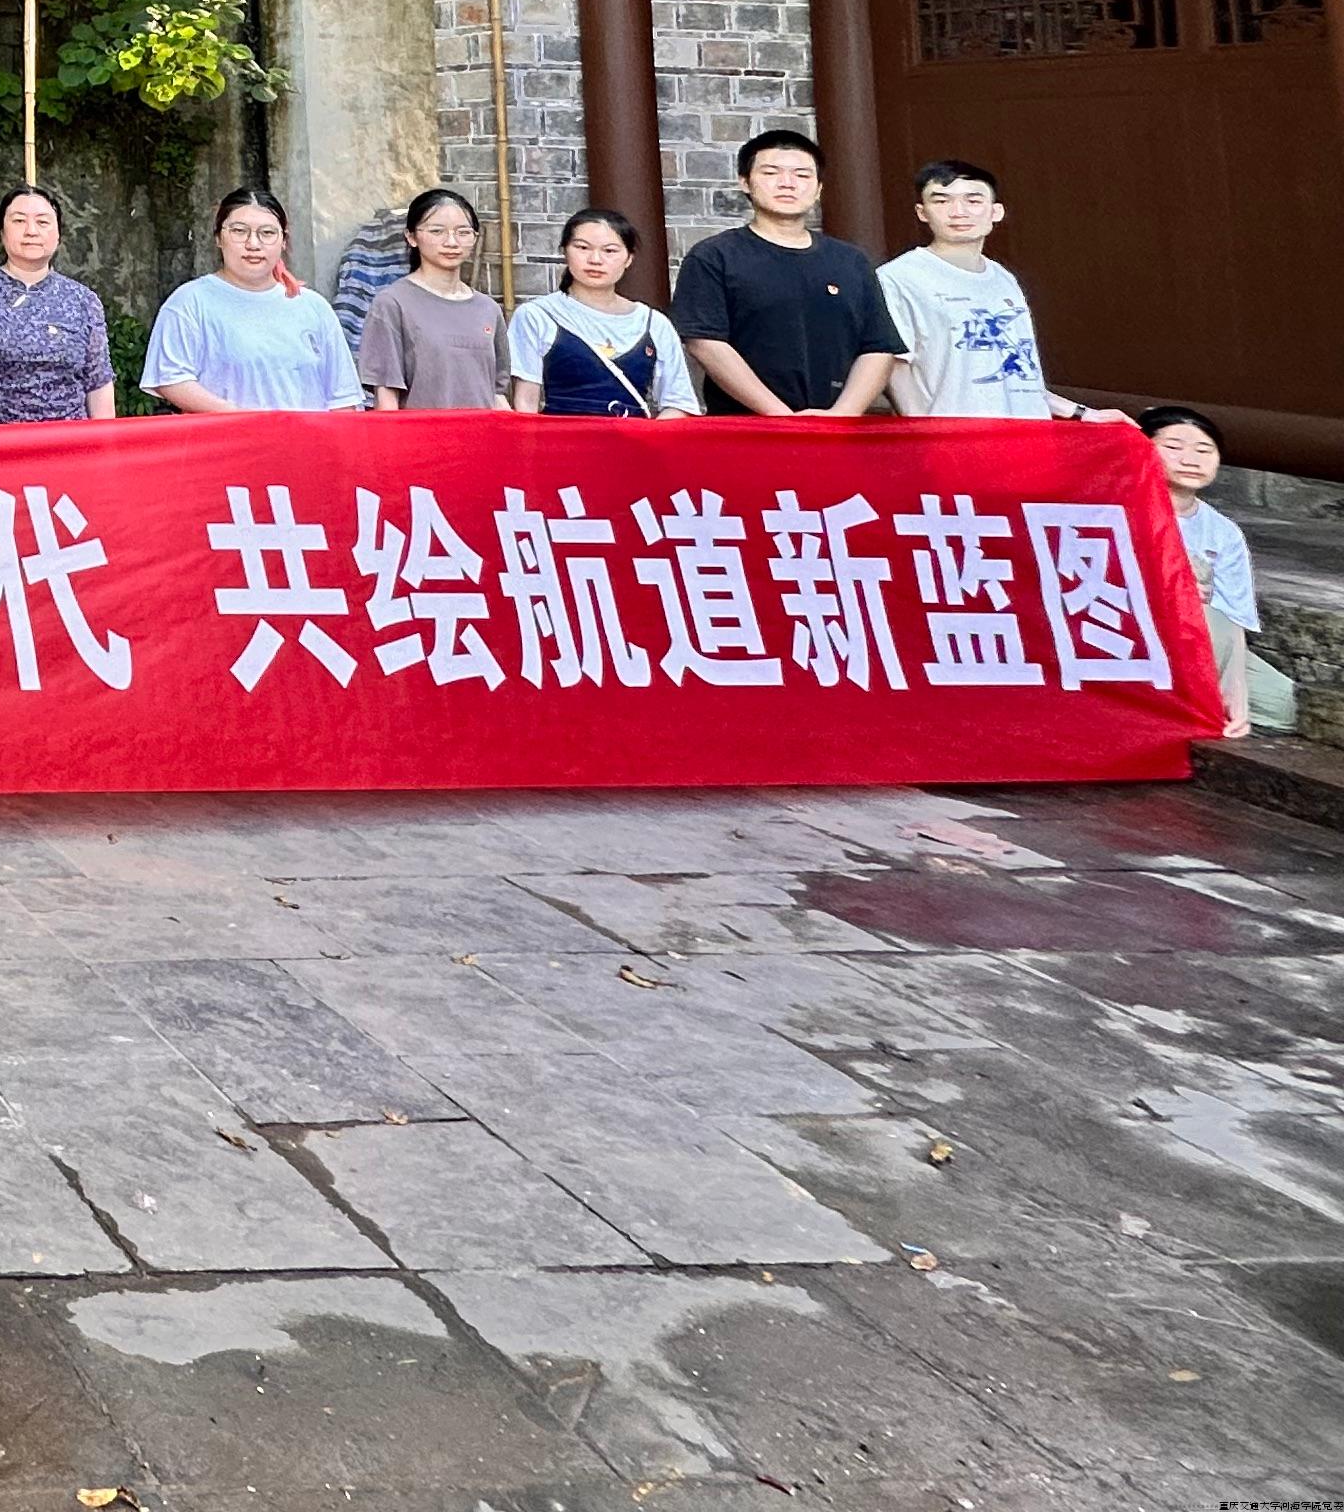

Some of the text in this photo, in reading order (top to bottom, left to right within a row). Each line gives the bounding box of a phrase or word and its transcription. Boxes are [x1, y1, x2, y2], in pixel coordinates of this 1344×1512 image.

[207, 485, 1173, 693] 共绘航道新蓝图
